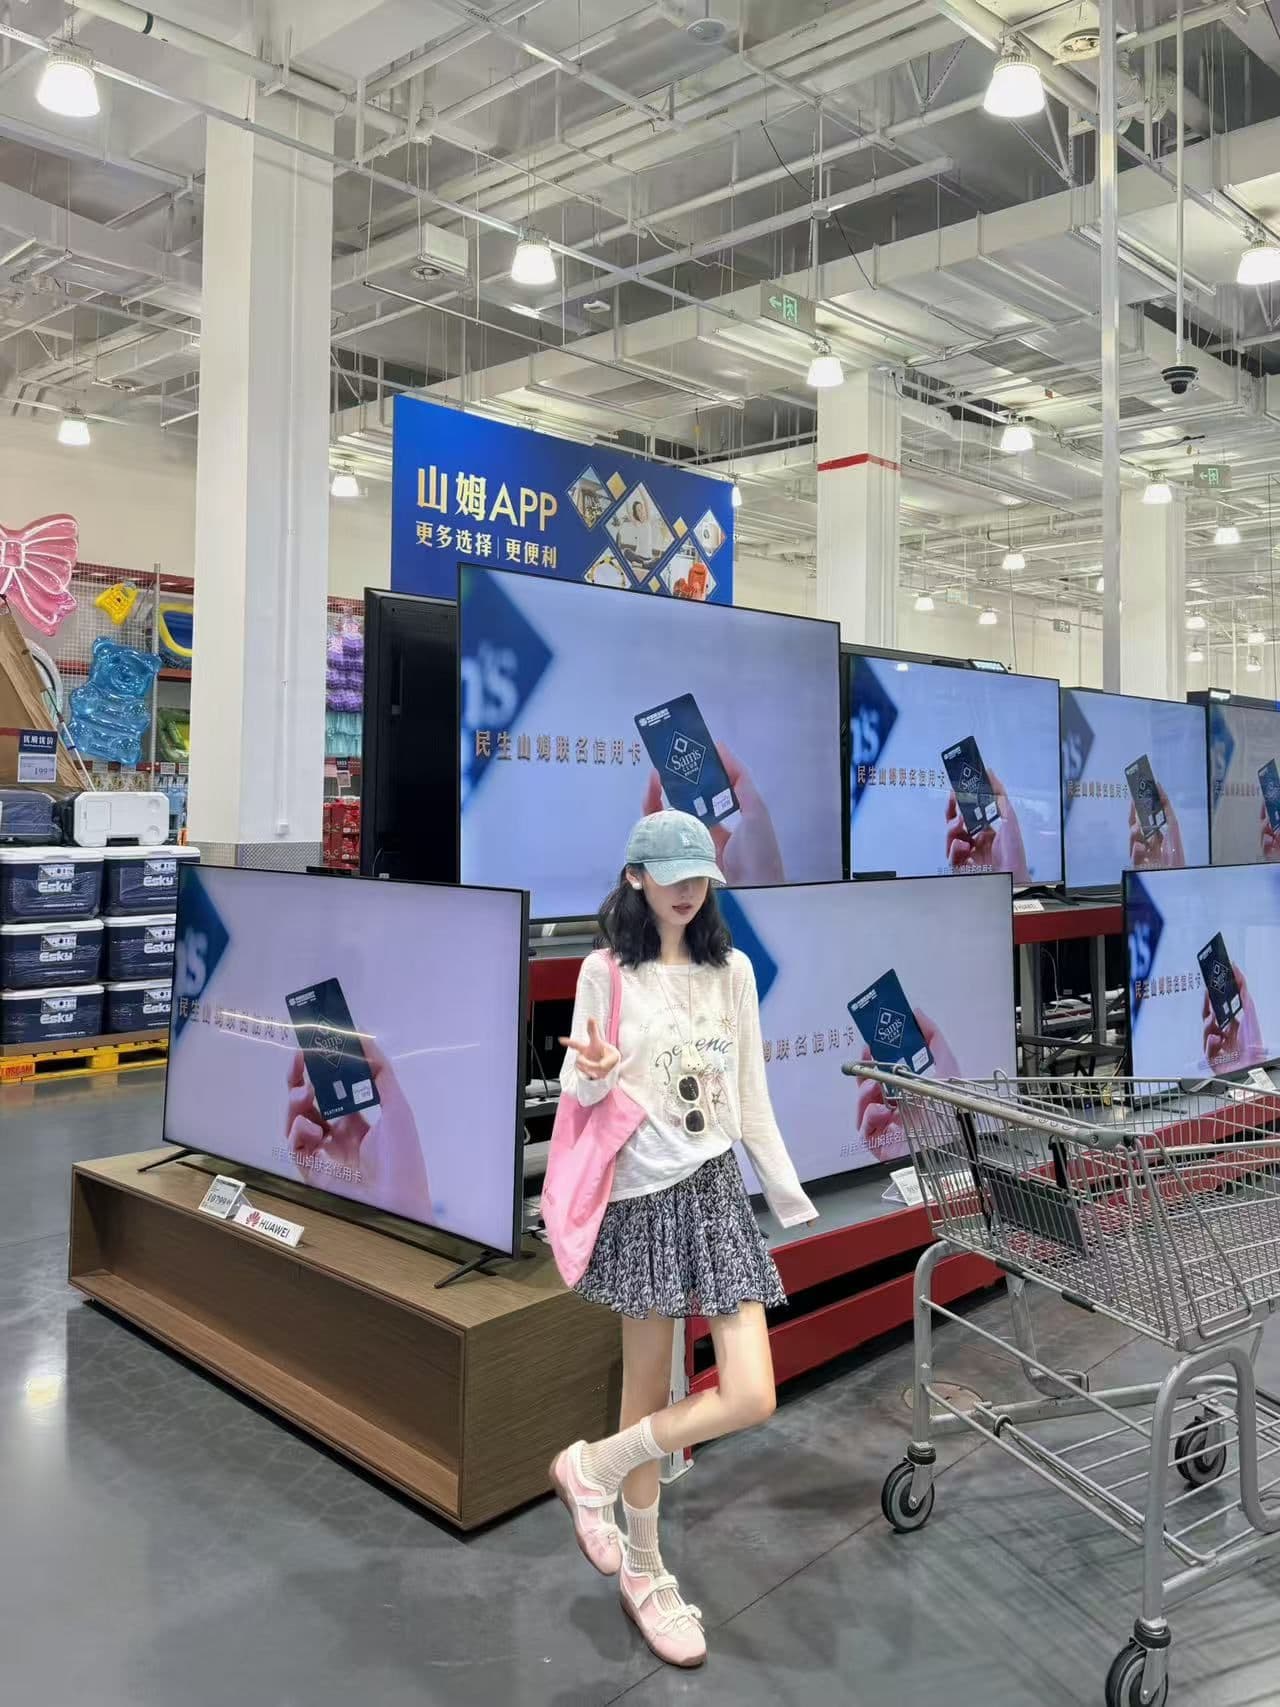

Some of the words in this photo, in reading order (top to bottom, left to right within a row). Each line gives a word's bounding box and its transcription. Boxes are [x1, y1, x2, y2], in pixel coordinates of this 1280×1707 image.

[416, 464, 558, 532] 山姆APP
[415, 520, 492, 557] 更多选择
[505, 537, 558, 569] 更便利
[475, 729, 641, 767] 民生山姆联名信用卡
[38, 880, 73, 893] Esky
[143, 875, 174, 887] Esky
[39, 951, 73, 962] Esky
[40, 1013, 74, 1025] Esky
[259, 1219, 291, 1239] HUAWEI
